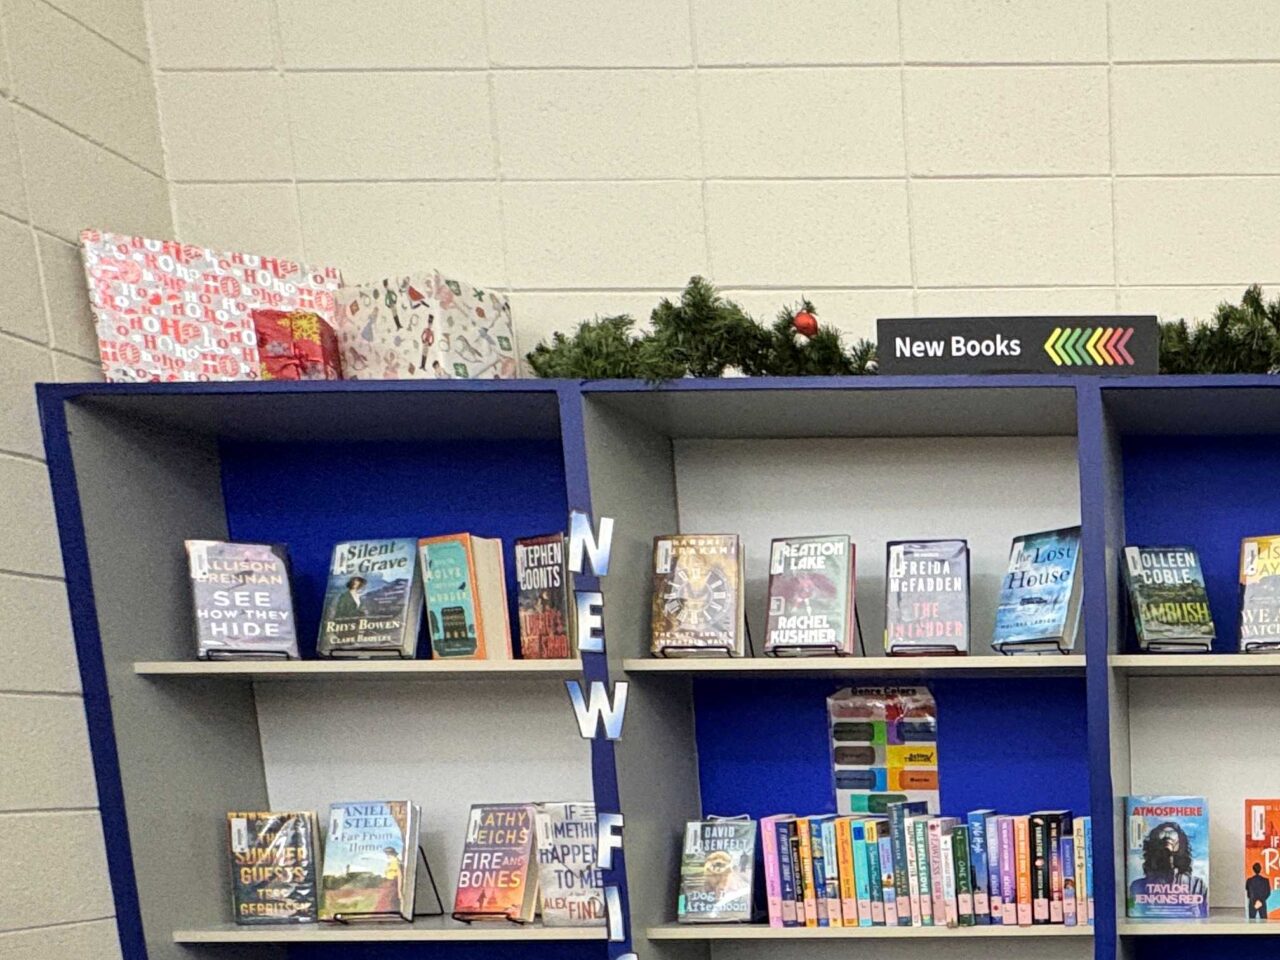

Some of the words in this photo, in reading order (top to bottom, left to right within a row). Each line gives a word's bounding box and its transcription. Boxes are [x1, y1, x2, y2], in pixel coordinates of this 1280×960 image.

[895, 336, 944, 358] New
[951, 334, 1021, 357] Books
[348, 540, 397, 561] Silent
[1033, 546, 1072, 565] Lost
[358, 555, 408, 575] Grave
[790, 556, 826, 570] LAKE
[904, 561, 951, 576] FREIDA
[519, 564, 561, 591] COONTS
[1007, 569, 1070, 590] House
[1142, 568, 1192, 585] COBLE
[890, 577, 962, 593] McFADDEN
[213, 591, 271, 607] SEE
[198, 609, 238, 620] HOW
[245, 609, 289, 621] THEY
[912, 602, 939, 618] THE
[1141, 601, 1209, 625] AMBUSH
[1242, 608, 1271, 624] WE
[211, 622, 280, 638] HIDE
[326, 621, 356, 633] RHYS
[358, 618, 401, 631] BOWEN
[778, 616, 830, 629] RACHEL
[770, 629, 837, 645] KUSHNER
[564, 804, 578, 821] IF
[1132, 806, 1203, 817] ATMOSPHERE
[344, 817, 393, 829] STEEL
[362, 831, 393, 842] From
[704, 825, 736, 839] DAVID
[915, 823, 925, 843] THIS
[349, 842, 383, 853] Home
[1270, 836, 1280, 848] IF
[462, 852, 503, 870] FIRE
[501, 855, 523, 867] AND
[917, 844, 927, 871] SPELLS
[930, 833, 940, 876] FLAWLESS
[240, 866, 305, 885] GUESTS
[458, 871, 522, 888] BONES
[554, 869, 574, 889] TO
[580, 869, 605, 889] ME
[919, 872, 929, 892] LOVE
[1146, 883, 1190, 894] TAYLOR
[544, 897, 568, 910] ALEX
[1135, 893, 1178, 905] JENKINS
[1178, 893, 1204, 905] REID
